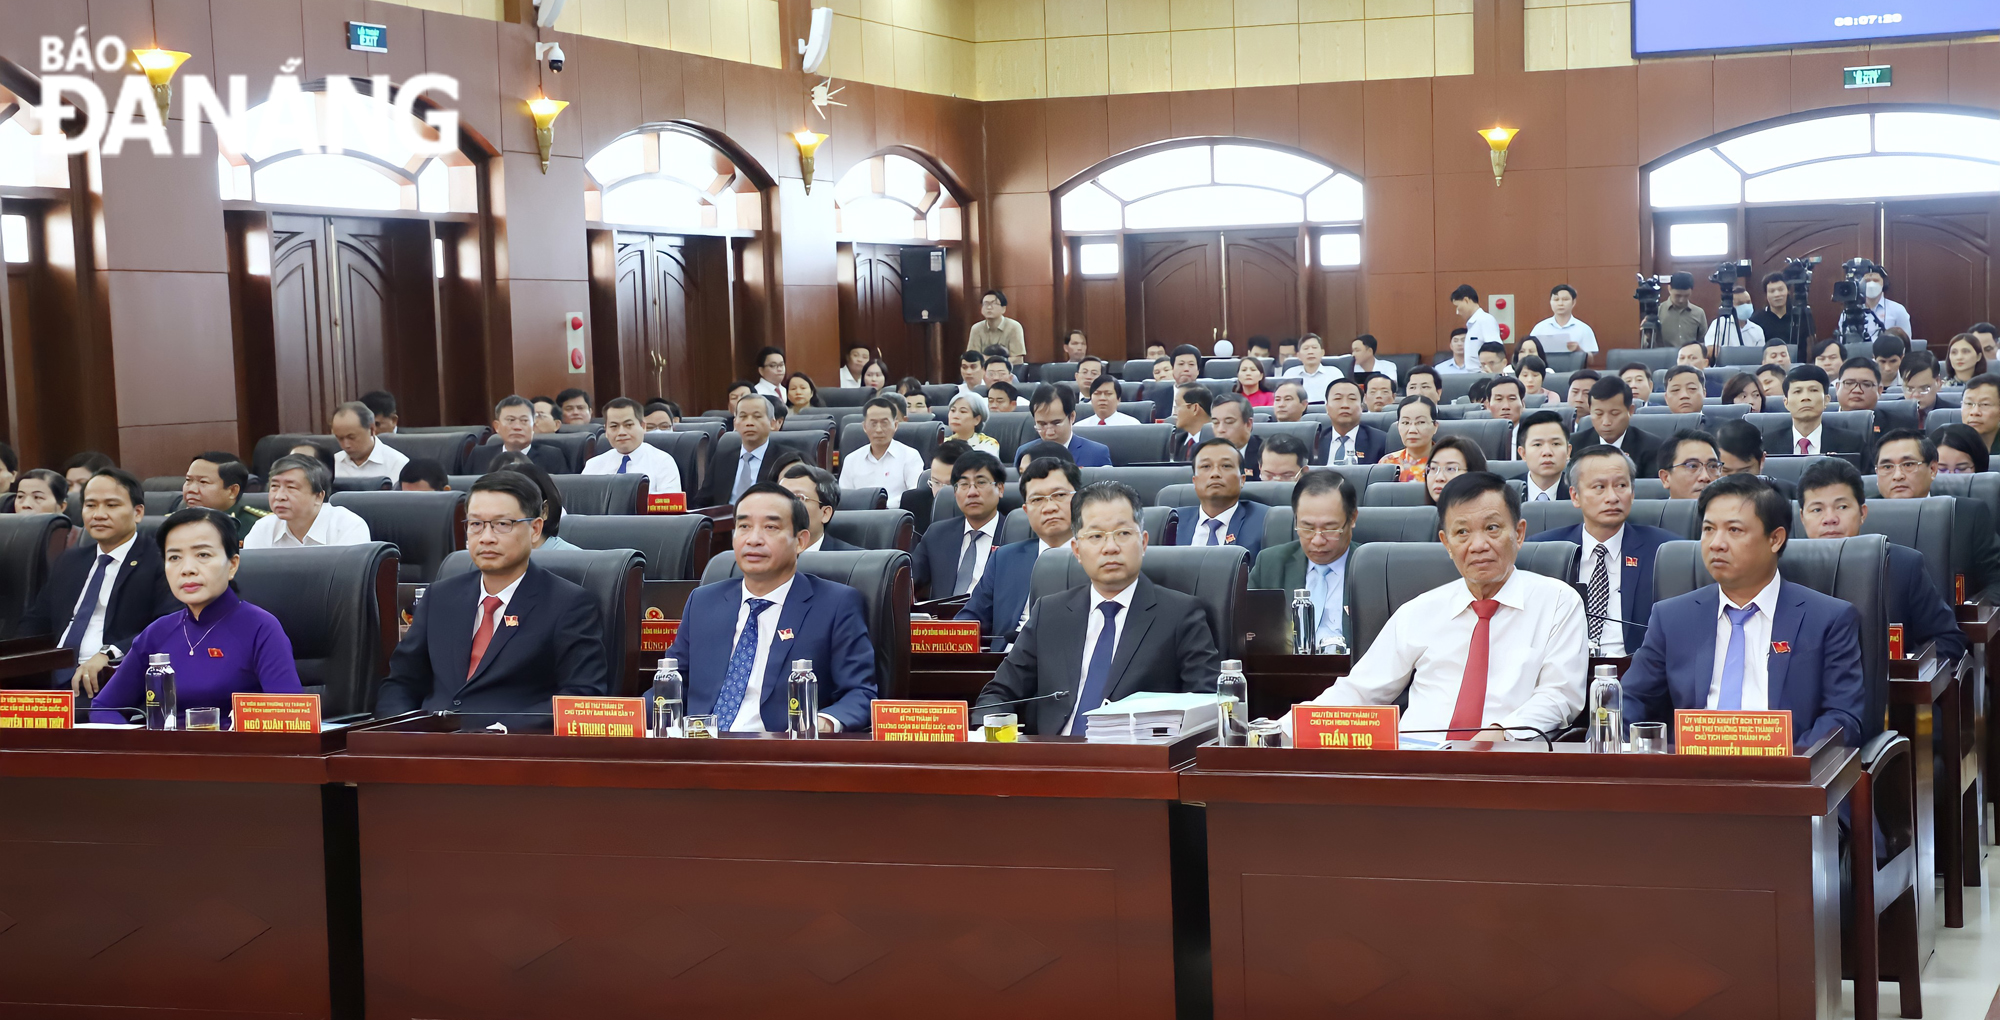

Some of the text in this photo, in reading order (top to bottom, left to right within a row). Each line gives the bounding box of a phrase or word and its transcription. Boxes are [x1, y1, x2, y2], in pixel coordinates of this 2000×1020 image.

[360, 34, 378, 46] EXIT
[244, 716, 311, 730] NGÔ XUÂN THẮNG
[568, 720, 577, 734] LÊ
[579, 723, 606, 735] TRUNG
